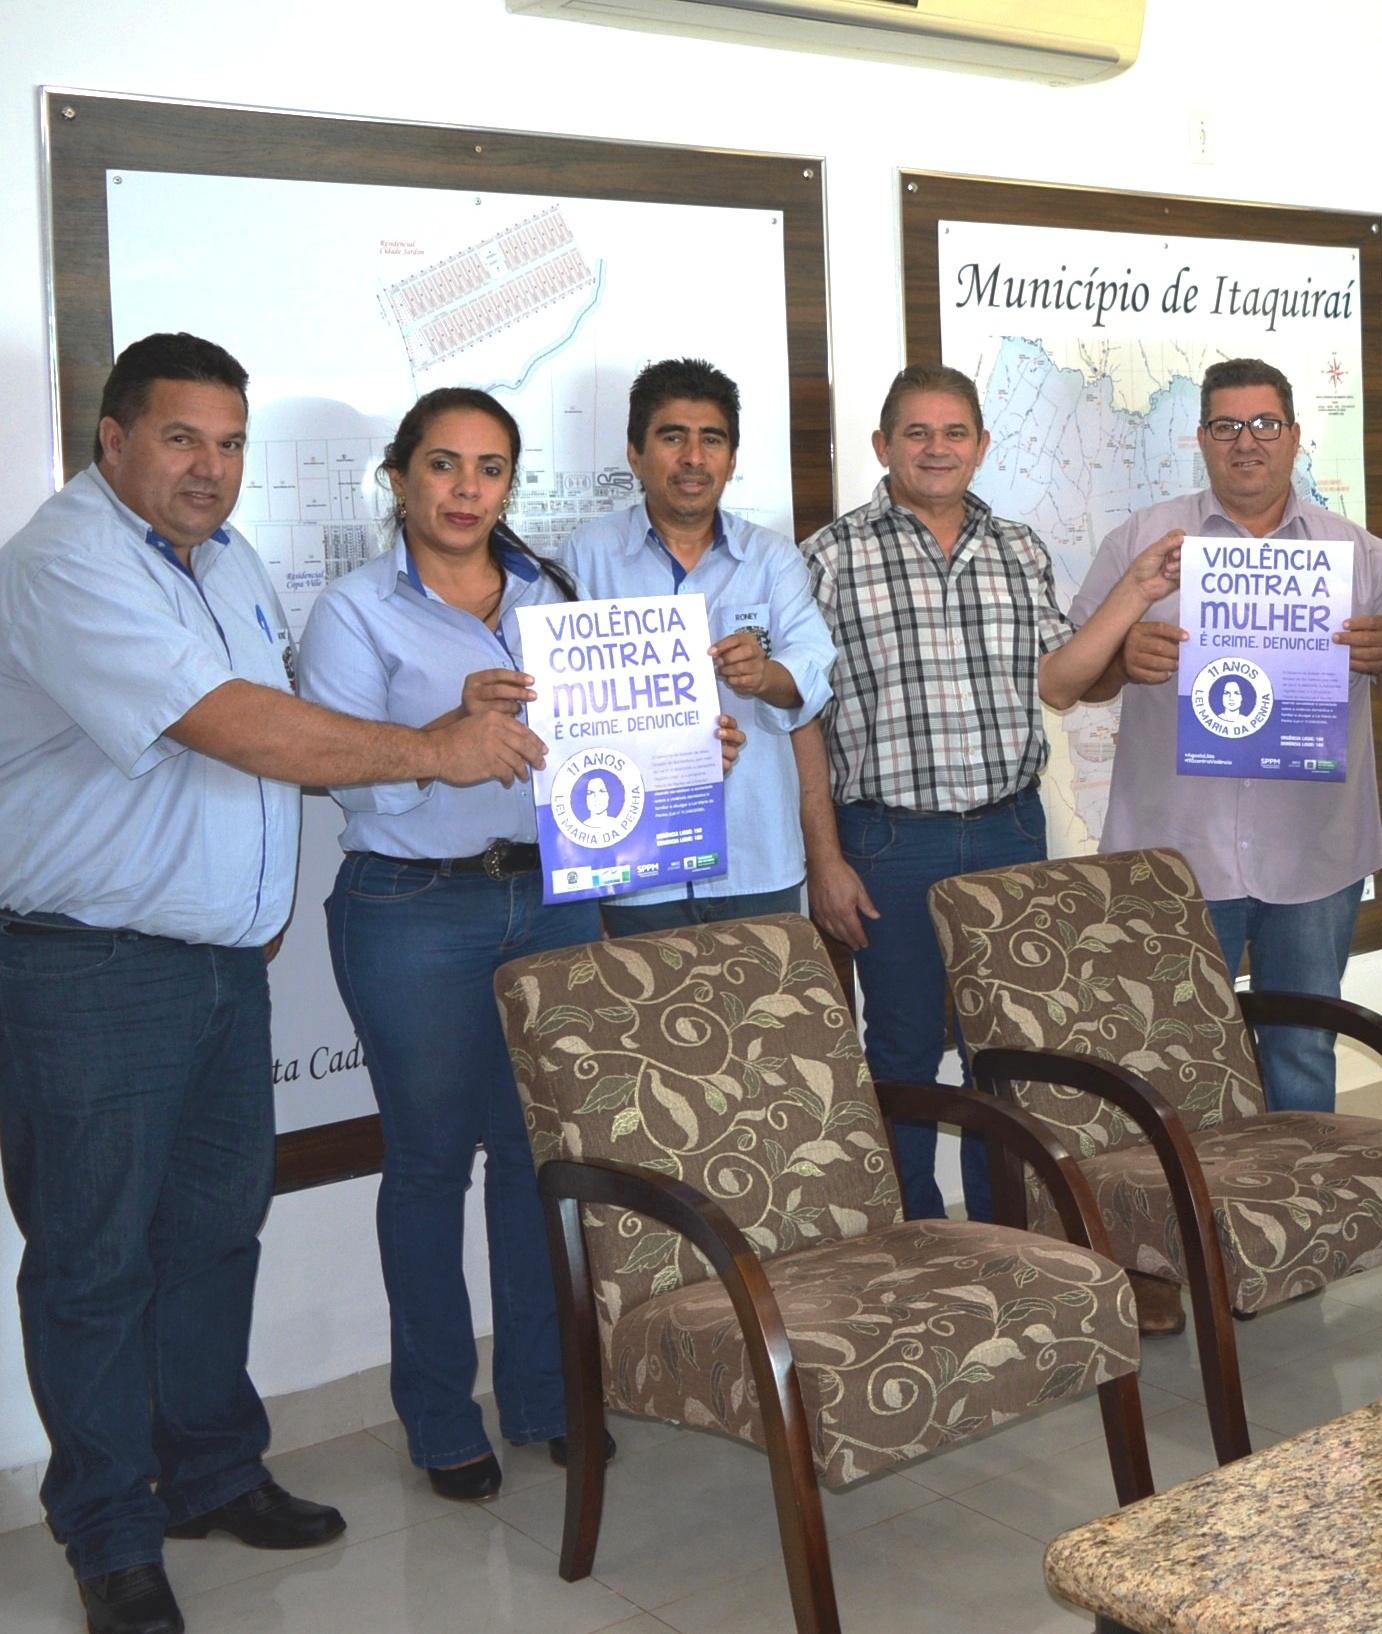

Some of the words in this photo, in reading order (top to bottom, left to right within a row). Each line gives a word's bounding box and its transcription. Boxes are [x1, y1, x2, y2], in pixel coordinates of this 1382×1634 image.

[955, 263, 1150, 328] Município
[1162, 267, 1199, 314] de
[1210, 276, 1355, 332] Itaquiraí
[1202, 543, 1331, 571] VIOLÊNCIA
[1201, 573, 1302, 597] CONTRA
[1312, 576, 1330, 598] A
[545, 604, 686, 641] VIOLÊNCIA
[1200, 600, 1331, 633] MULHER
[550, 641, 661, 673] CONTRA
[671, 638, 690, 663] A
[1200, 632, 1208, 646] É
[1212, 634, 1258, 648] CRIME.
[1263, 636, 1330, 651] DENUNCIE!
[1222, 661, 1259, 680] ANOS
[553, 671, 697, 718] MULHER
[1195, 689, 1204, 707] LEI
[554, 722, 564, 740] É
[569, 719, 623, 738] CRIME.
[627, 710, 700, 732] DENUNCIE!
[1199, 709, 1229, 735] MARIA
[1250, 693, 1270, 728] PENHA
[1233, 725, 1249, 736] DA
[583, 753, 626, 771] ANOS
[554, 795, 565, 816] LEI
[561, 818, 598, 845] MARIA
[602, 830, 620, 843] DA
[622, 785, 641, 831] PENHA
[272, 1059, 301, 1084] ta
[310, 1040, 367, 1080] Cad
